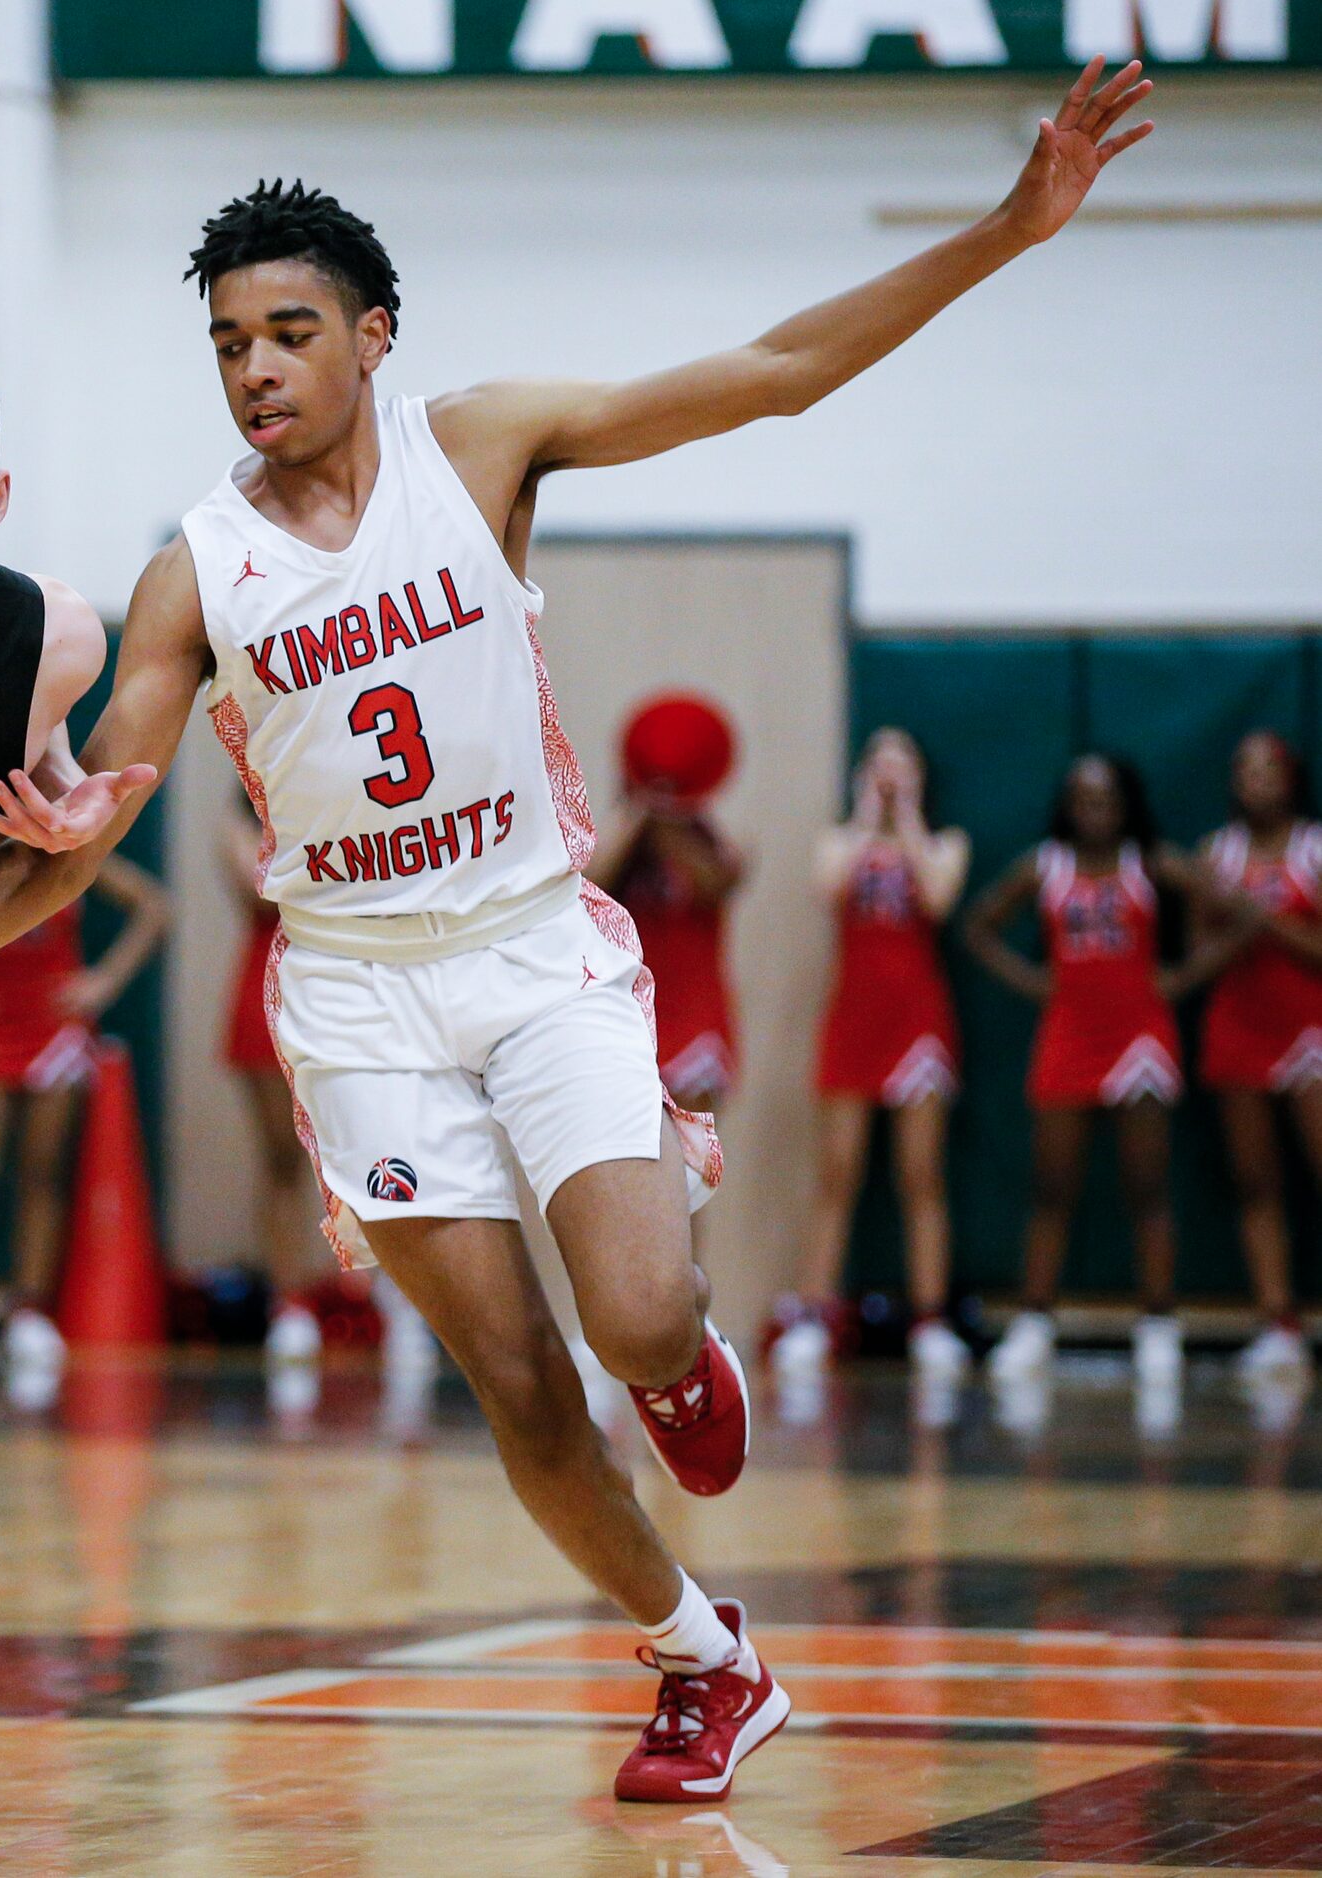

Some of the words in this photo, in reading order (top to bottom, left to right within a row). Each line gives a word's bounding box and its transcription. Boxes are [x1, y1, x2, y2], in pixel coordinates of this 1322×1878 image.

[244, 567, 484, 695] KIMBALL
[347, 681, 435, 810] 3
[303, 789, 515, 883] KNIGHTS
